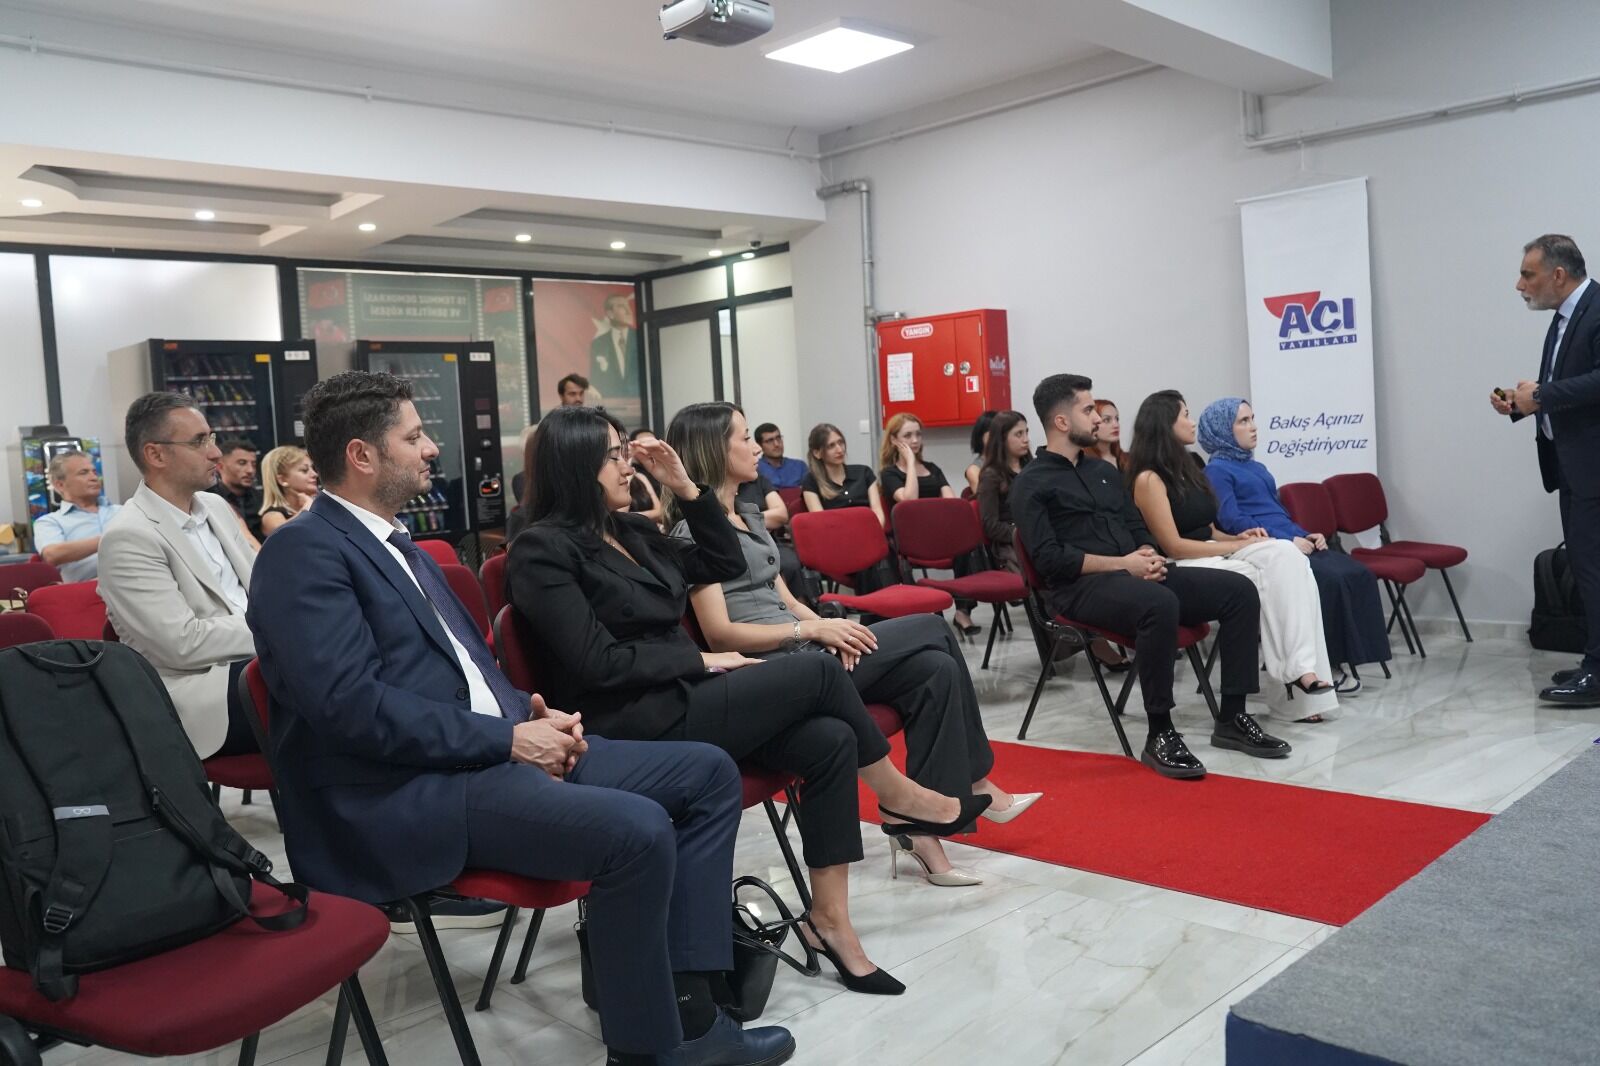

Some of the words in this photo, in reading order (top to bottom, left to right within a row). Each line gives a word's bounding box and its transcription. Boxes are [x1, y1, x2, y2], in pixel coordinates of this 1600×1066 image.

[904, 326, 930, 336] YANGIN
[1280, 335, 1357, 350] YAYINLARI
[1269, 415, 1310, 432] Bakış
[1313, 412, 1364, 430] Açınızı
[1266, 436, 1369, 458] Değiştiriyoruz
